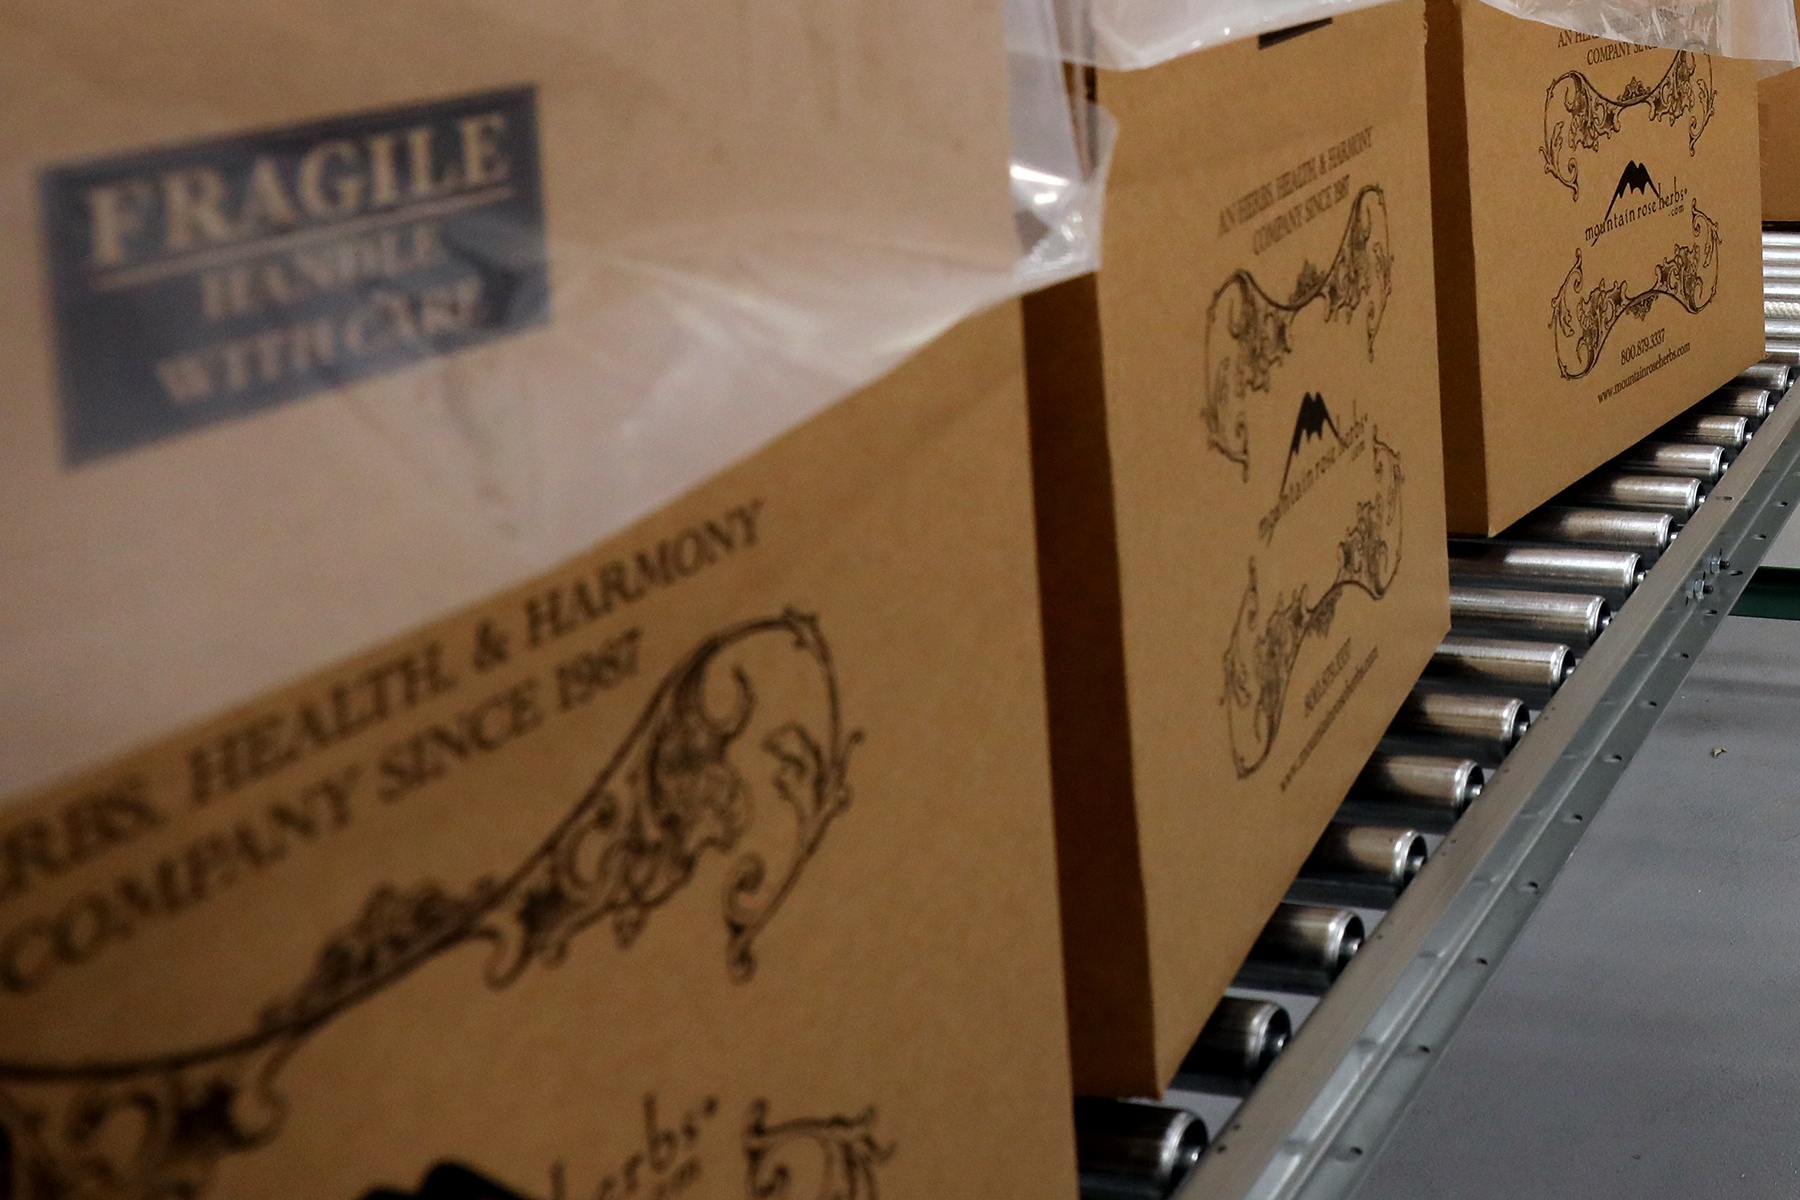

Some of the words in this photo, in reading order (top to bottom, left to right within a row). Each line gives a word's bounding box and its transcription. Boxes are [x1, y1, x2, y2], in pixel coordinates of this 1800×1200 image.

[1557, 29, 1573, 48] AN
[1587, 41, 1631, 65] COMPANY
[85, 112, 510, 267] FRAGILE
[1585, 209, 1636, 242] mountain
[1637, 200, 1657, 219] rose
[1658, 176, 1684, 210] herbs
[1668, 204, 1685, 217] .com
[202, 216, 449, 320] HANDLE
[154, 320, 337, 406] WITH
[1597, 342, 1691, 404] www.mountainroseherbs.com
[471, 614, 510, 672] &
[523, 501, 763, 649] HARMONY
[0, 763, 359, 993] COMPANY
[376, 676, 549, 803] SINCE
[555, 627, 644, 712] 1987
